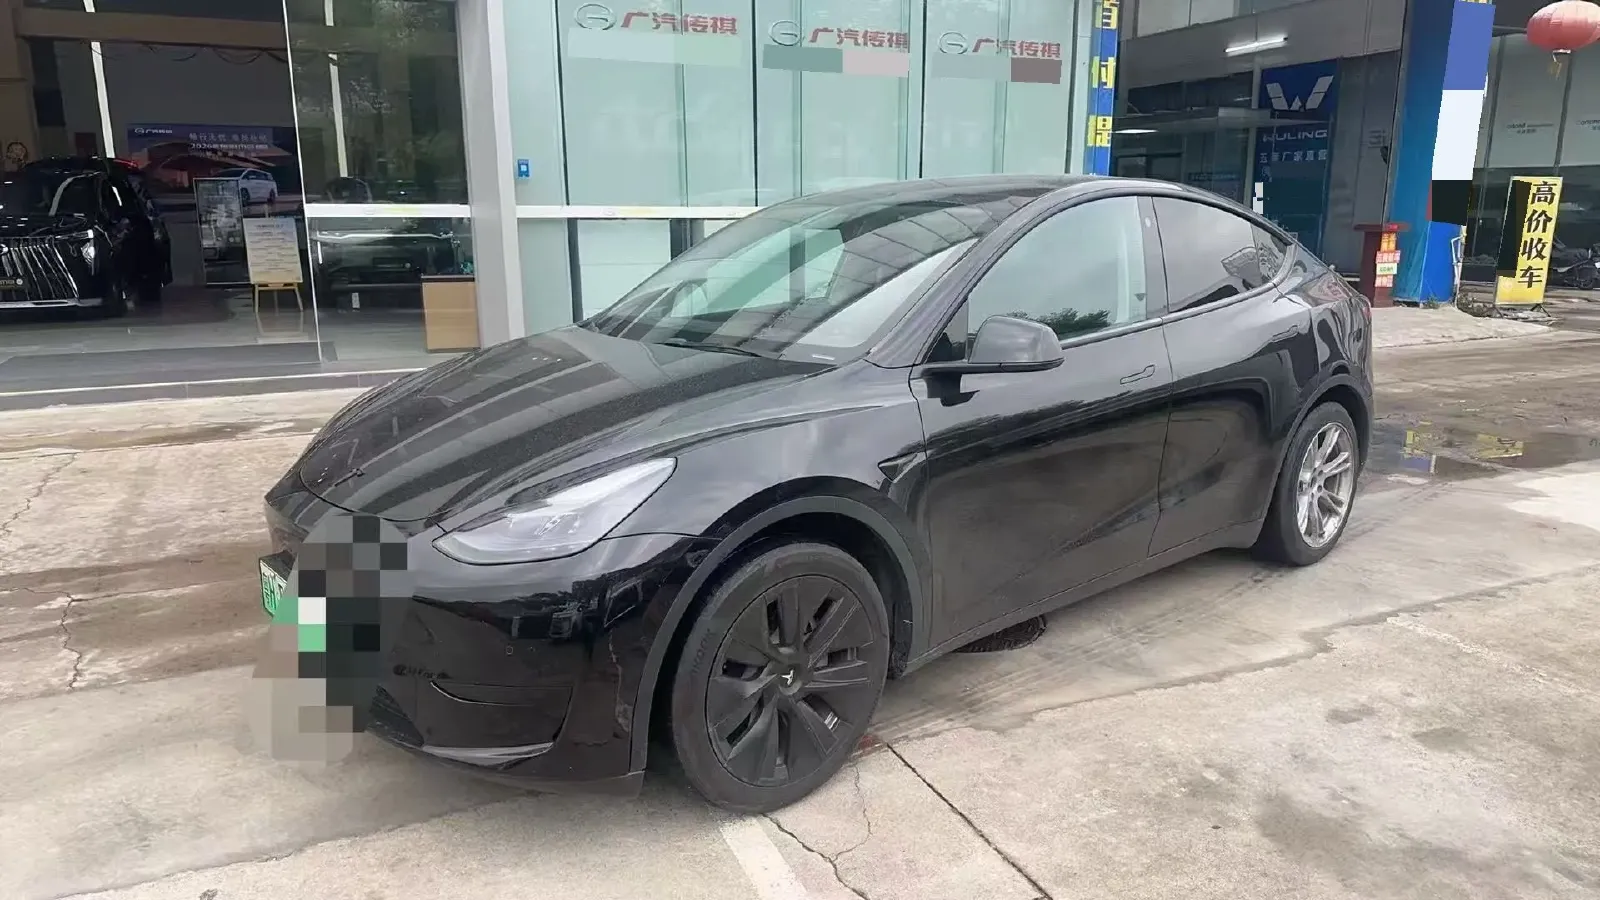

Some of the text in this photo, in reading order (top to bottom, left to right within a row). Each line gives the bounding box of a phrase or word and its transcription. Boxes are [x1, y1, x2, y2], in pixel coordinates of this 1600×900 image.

[620, 12, 737, 34] 广汽传祺
[808, 27, 909, 49] 广汽传祺
[972, 38, 1061, 58] 广汽传祺
[1262, 129, 1328, 142] WULING
[1517, 180, 1558, 289] 高价收车
